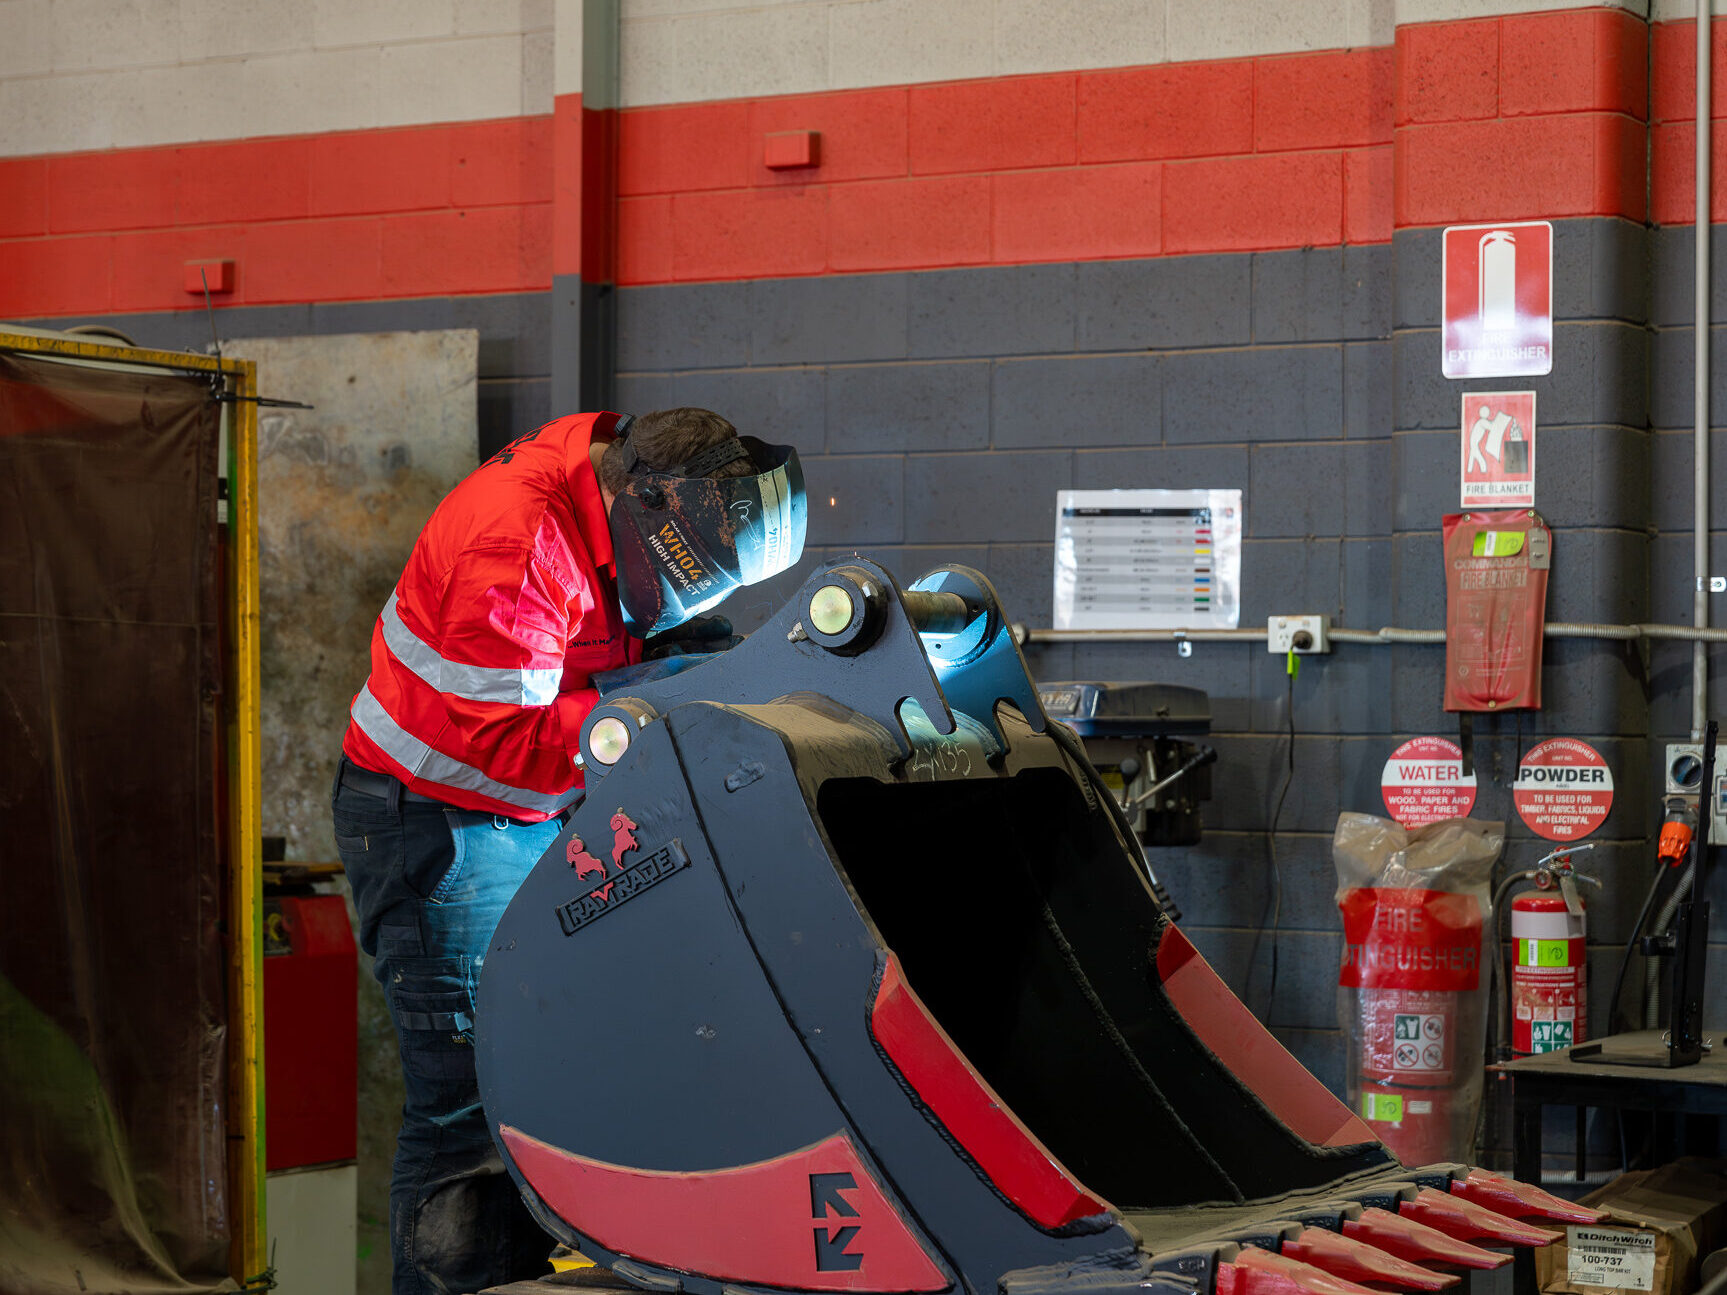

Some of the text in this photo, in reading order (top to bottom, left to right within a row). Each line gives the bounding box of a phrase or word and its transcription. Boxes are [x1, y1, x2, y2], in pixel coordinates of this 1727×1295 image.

[1449, 346, 1546, 362] EXTINGUISHER
[1466, 483, 1529, 495] FIRE BLANKET
[648, 534, 670, 561] HIGH
[667, 561, 701, 595] IMPACT
[1543, 741, 1596, 762] EXTINGUISHER
[1399, 765, 1459, 780] WATER
[1520, 768, 1605, 782] POWDER
[1421, 796, 1448, 804] PAPER
[1452, 796, 1470, 805] AND
[1534, 794, 1592, 803] TO BE USED FOR
[1400, 805, 1458, 813] FABRIC FIRES
[1578, 805, 1605, 814] LIQUIDS
[1536, 815, 1550, 824] AND
[1553, 825, 1572, 834] FIRES
[1373, 907, 1424, 932] FIRE
[1582, 1255, 1623, 1266] 100-737
